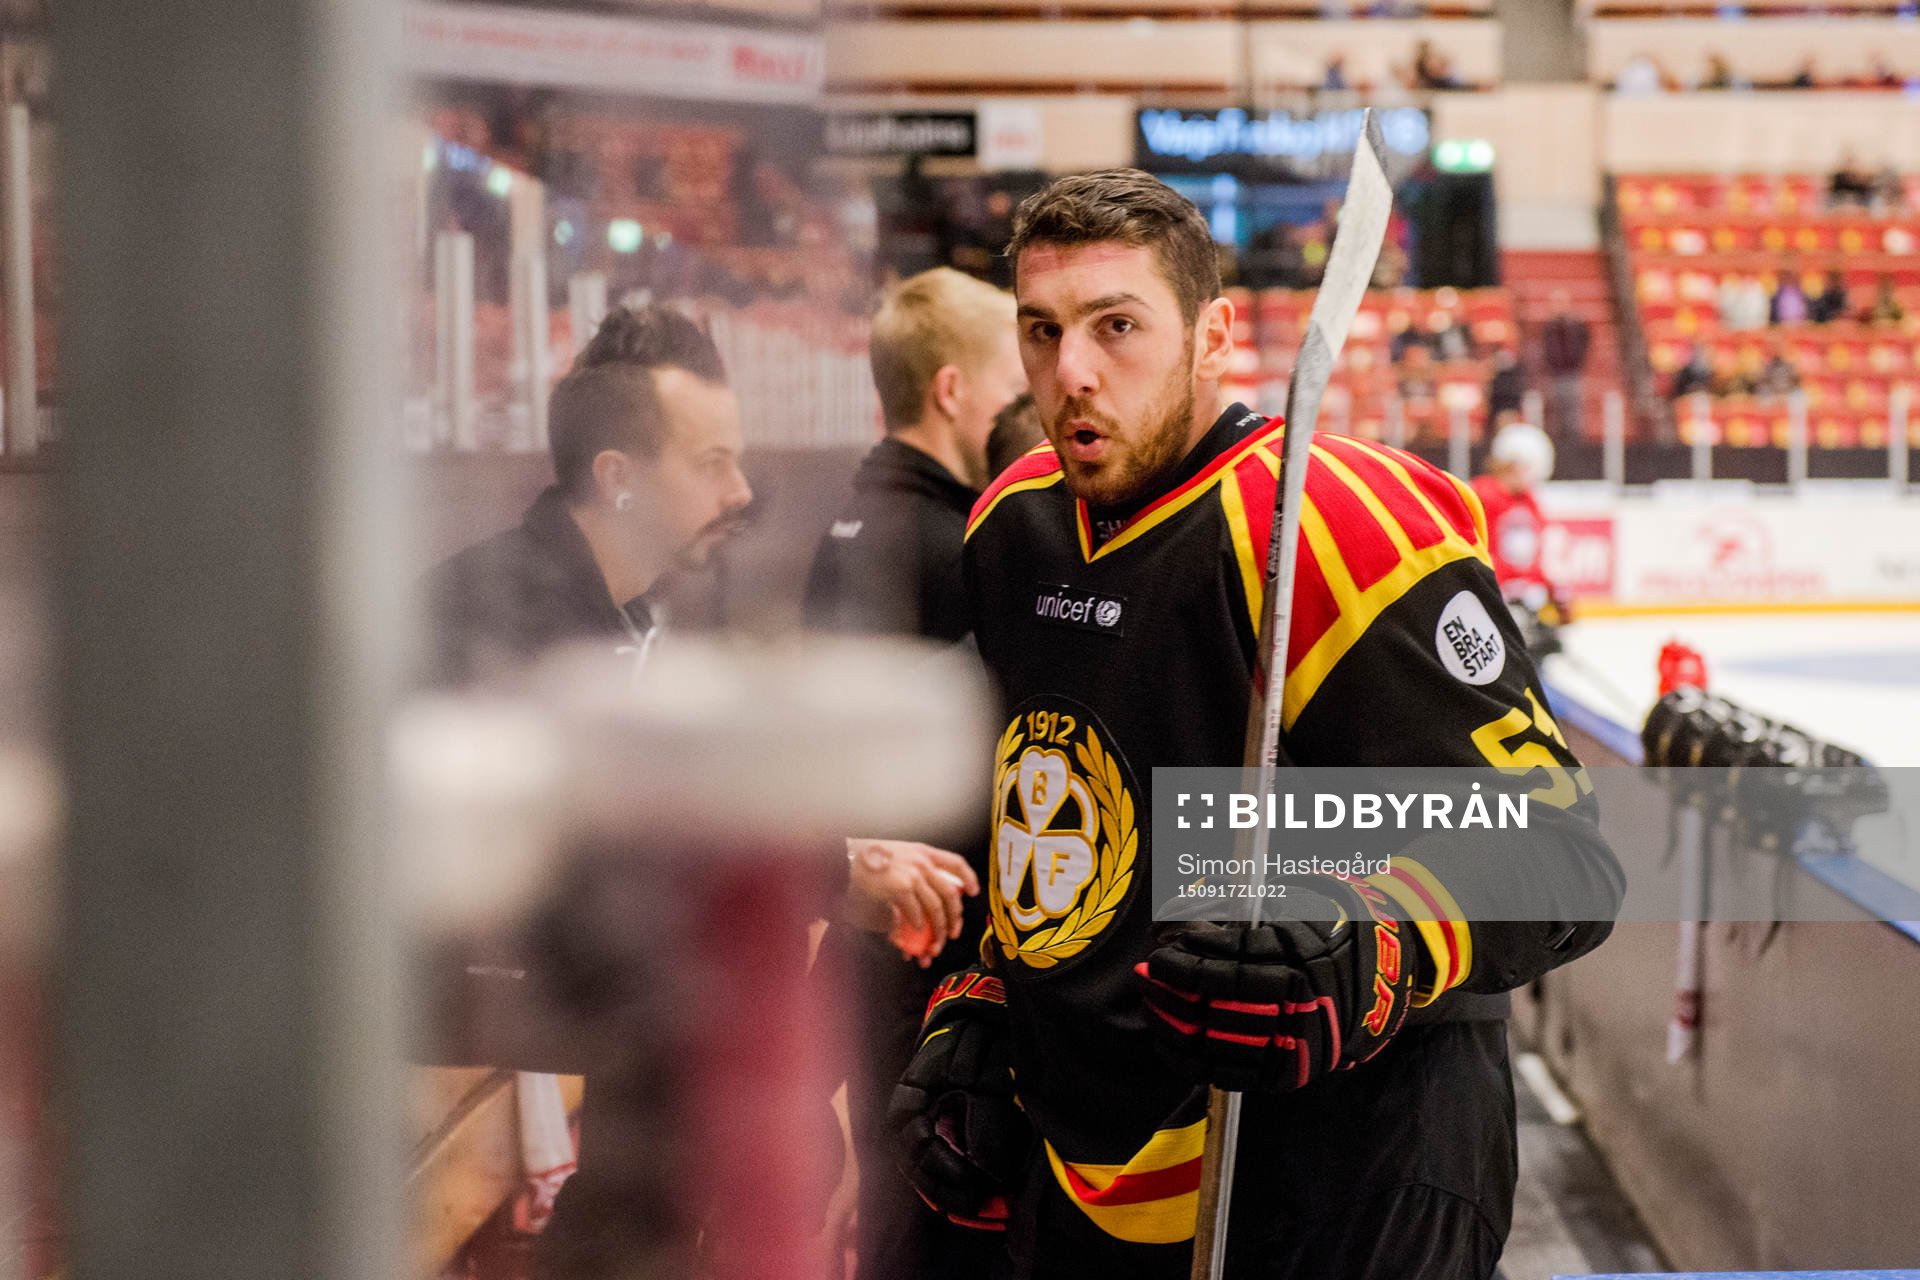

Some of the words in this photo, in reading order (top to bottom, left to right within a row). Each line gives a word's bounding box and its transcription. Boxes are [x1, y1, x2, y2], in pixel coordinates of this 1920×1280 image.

[1036, 591, 1095, 624] unicef
[1443, 615, 1466, 643] EN
[1453, 627, 1483, 661] BRA
[1463, 633, 1499, 677] START
[1026, 710, 1077, 747] 1912
[1031, 770, 1048, 806] B
[1048, 851, 1071, 887] F
